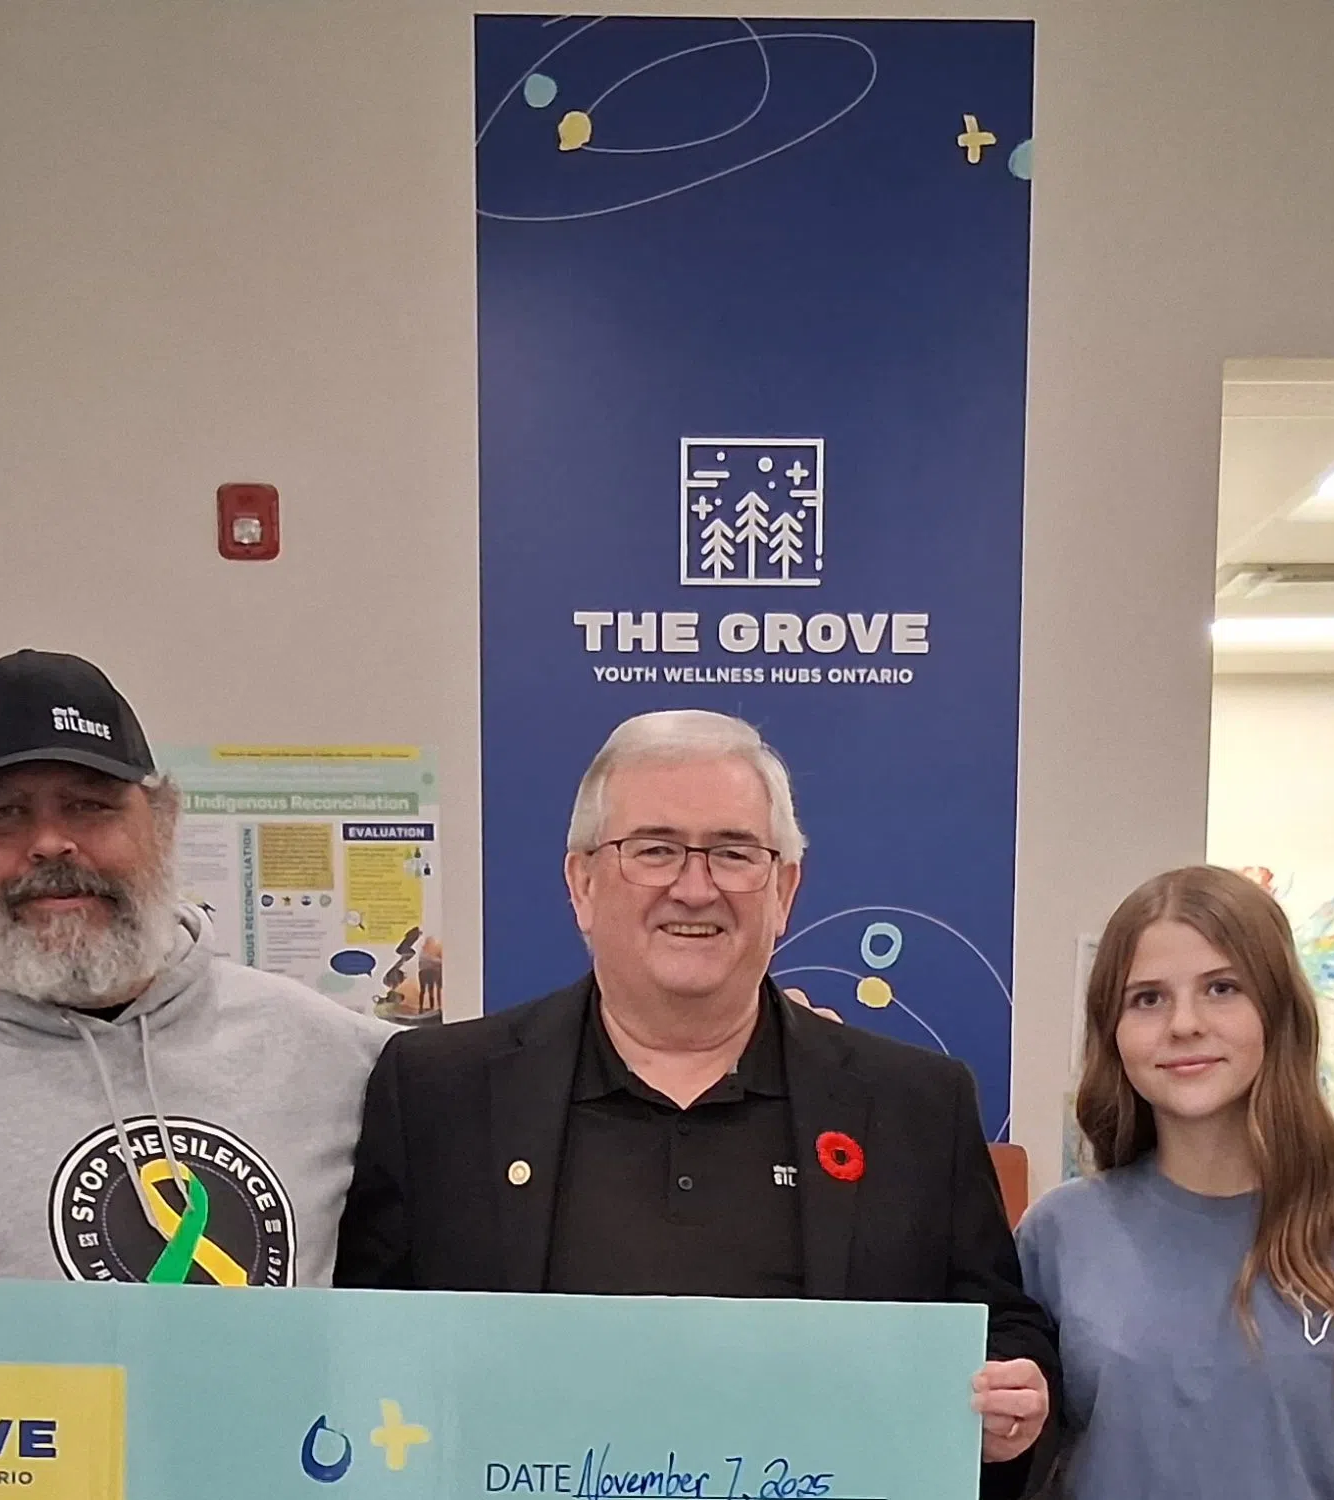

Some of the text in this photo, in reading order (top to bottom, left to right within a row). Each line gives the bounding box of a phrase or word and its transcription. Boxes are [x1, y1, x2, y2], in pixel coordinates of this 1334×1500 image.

[574, 611, 929, 653] THE GROVE
[593, 666, 913, 684] YOUTH WELLNESS HUBS ONTARIO
[53, 716, 112, 741] SILENCE
[194, 795, 289, 814] Indigenous
[291, 795, 410, 811] Reconciliation
[348, 826, 425, 838] EVALUATION
[242, 828, 255, 930] RECONCILIATION
[71, 1134, 276, 1222] STOP THE SILENCE
[264, 1246, 283, 1286] JECT
[485, 1462, 571, 1493] DATE
[761, 1457, 833, 1499] 2025
